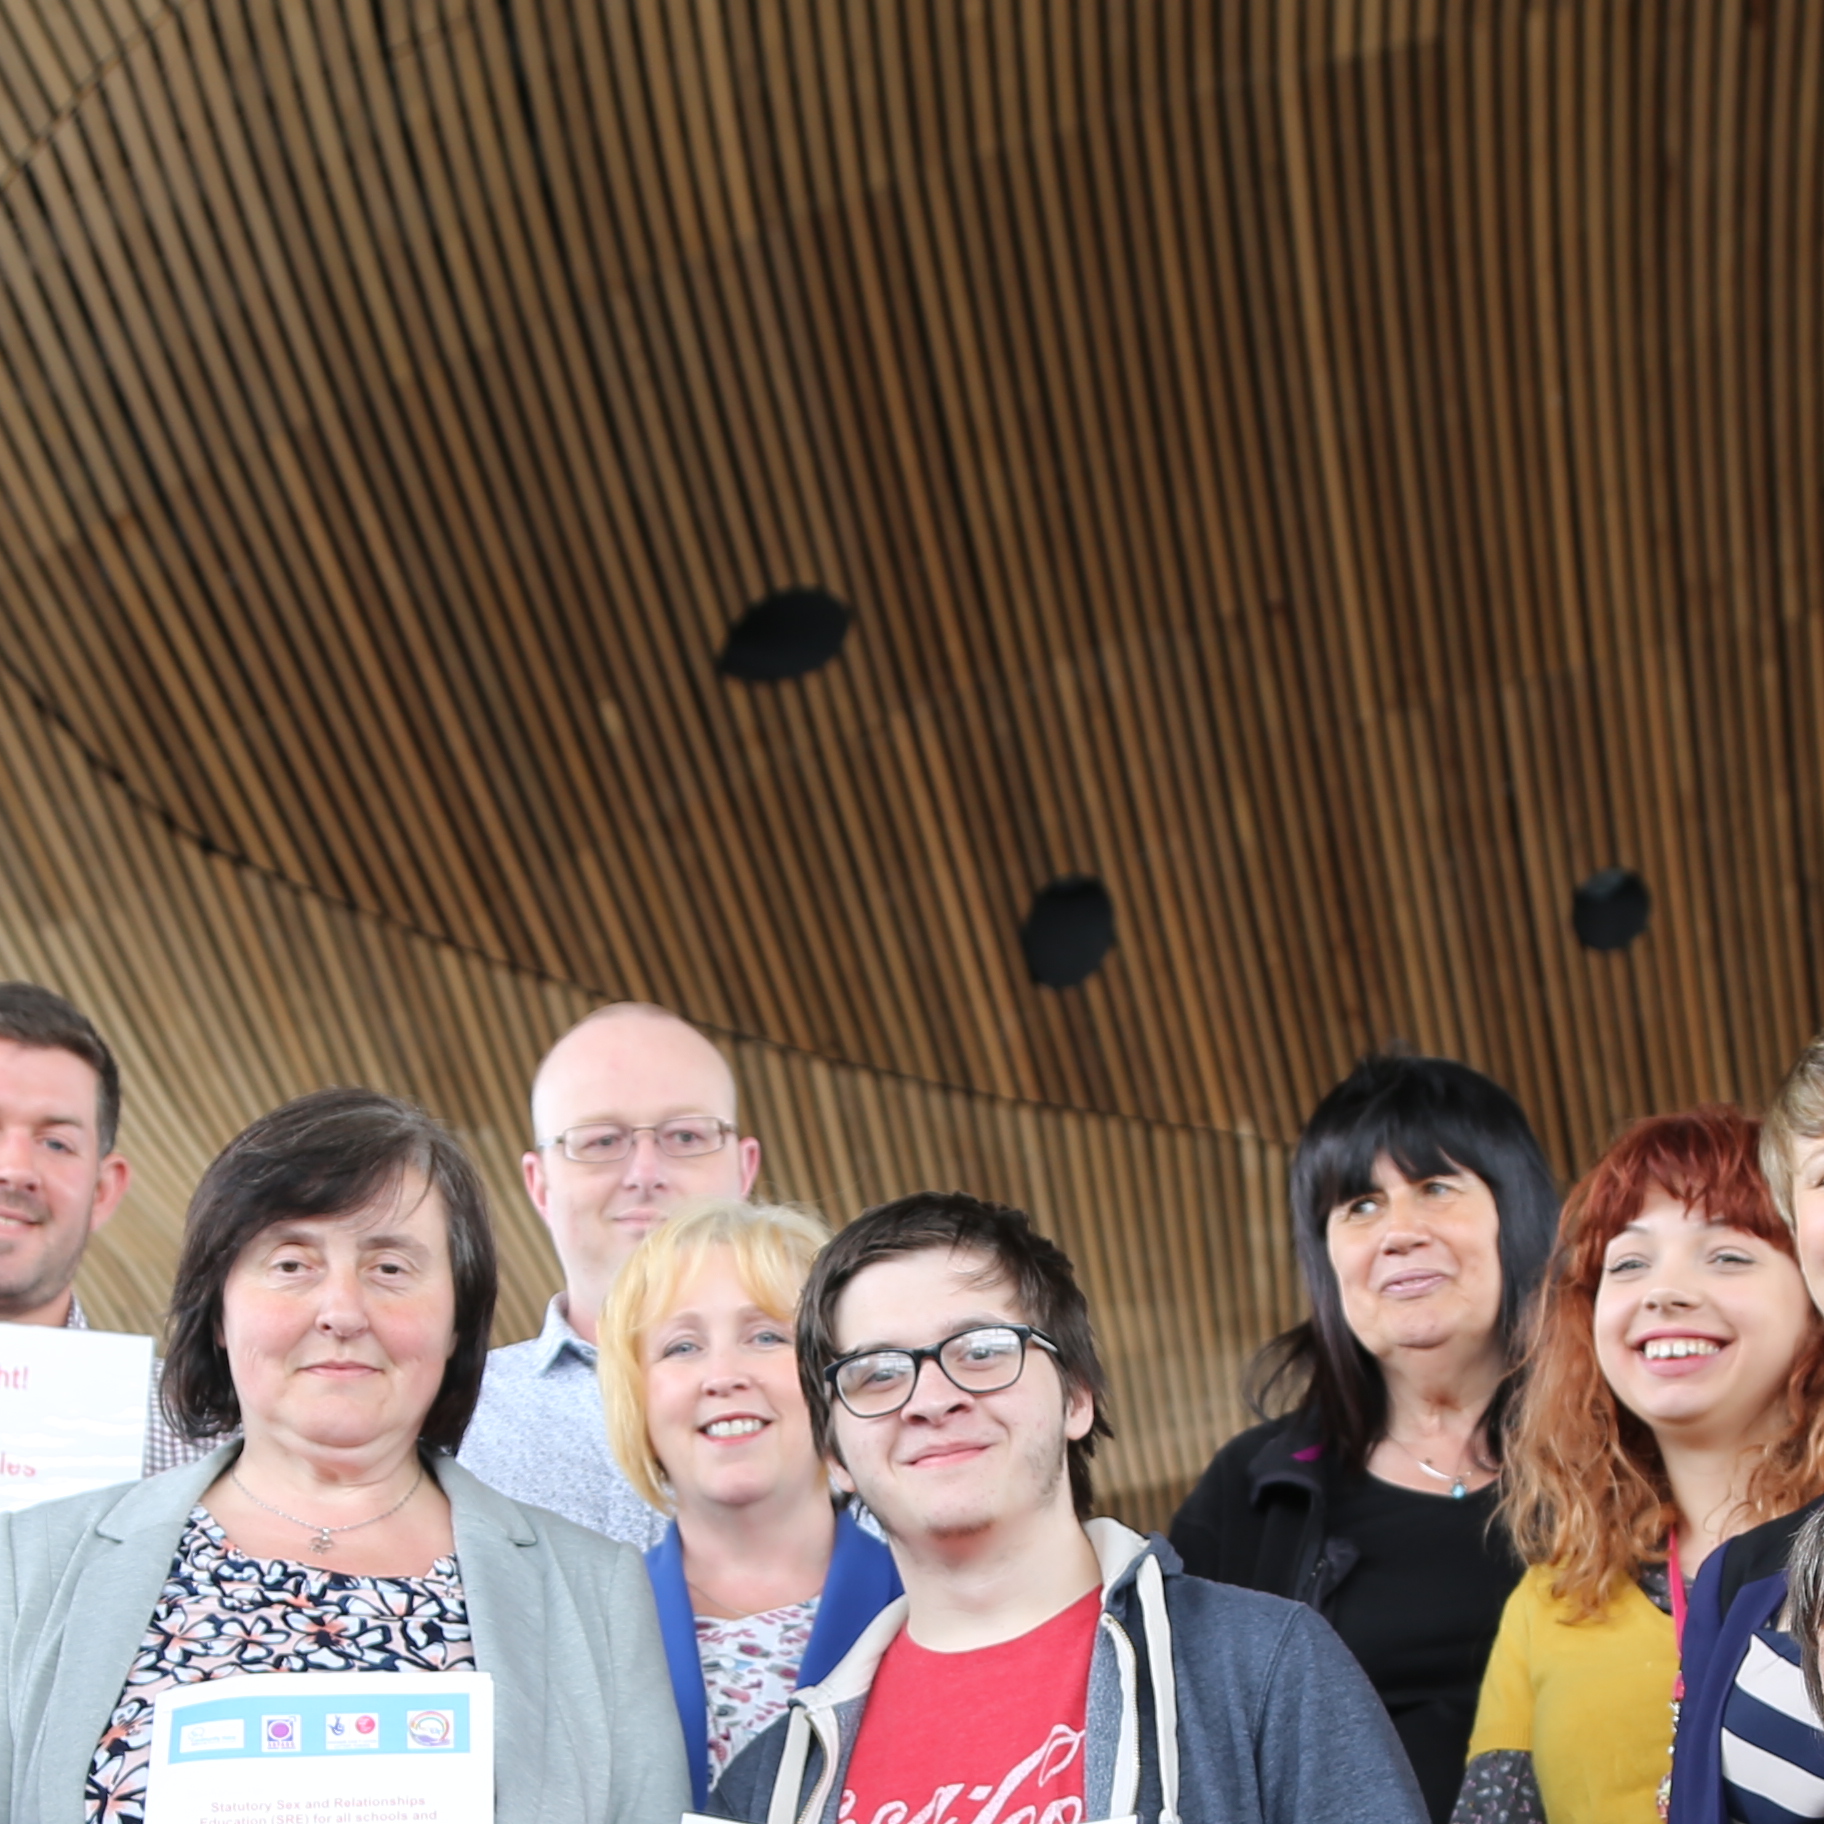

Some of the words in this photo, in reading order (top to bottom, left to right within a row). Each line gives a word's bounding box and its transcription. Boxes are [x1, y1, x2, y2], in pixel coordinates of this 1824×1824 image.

[211, 1802, 272, 1815] Statutory
[277, 1800, 301, 1810] Sex
[305, 1798, 329, 1809] and
[334, 1796, 426, 1809] Relationships
[313, 1814, 332, 1824] for
[336, 1812, 352, 1823] all
[355, 1811, 408, 1822] schools
[413, 1810, 438, 1821] and
